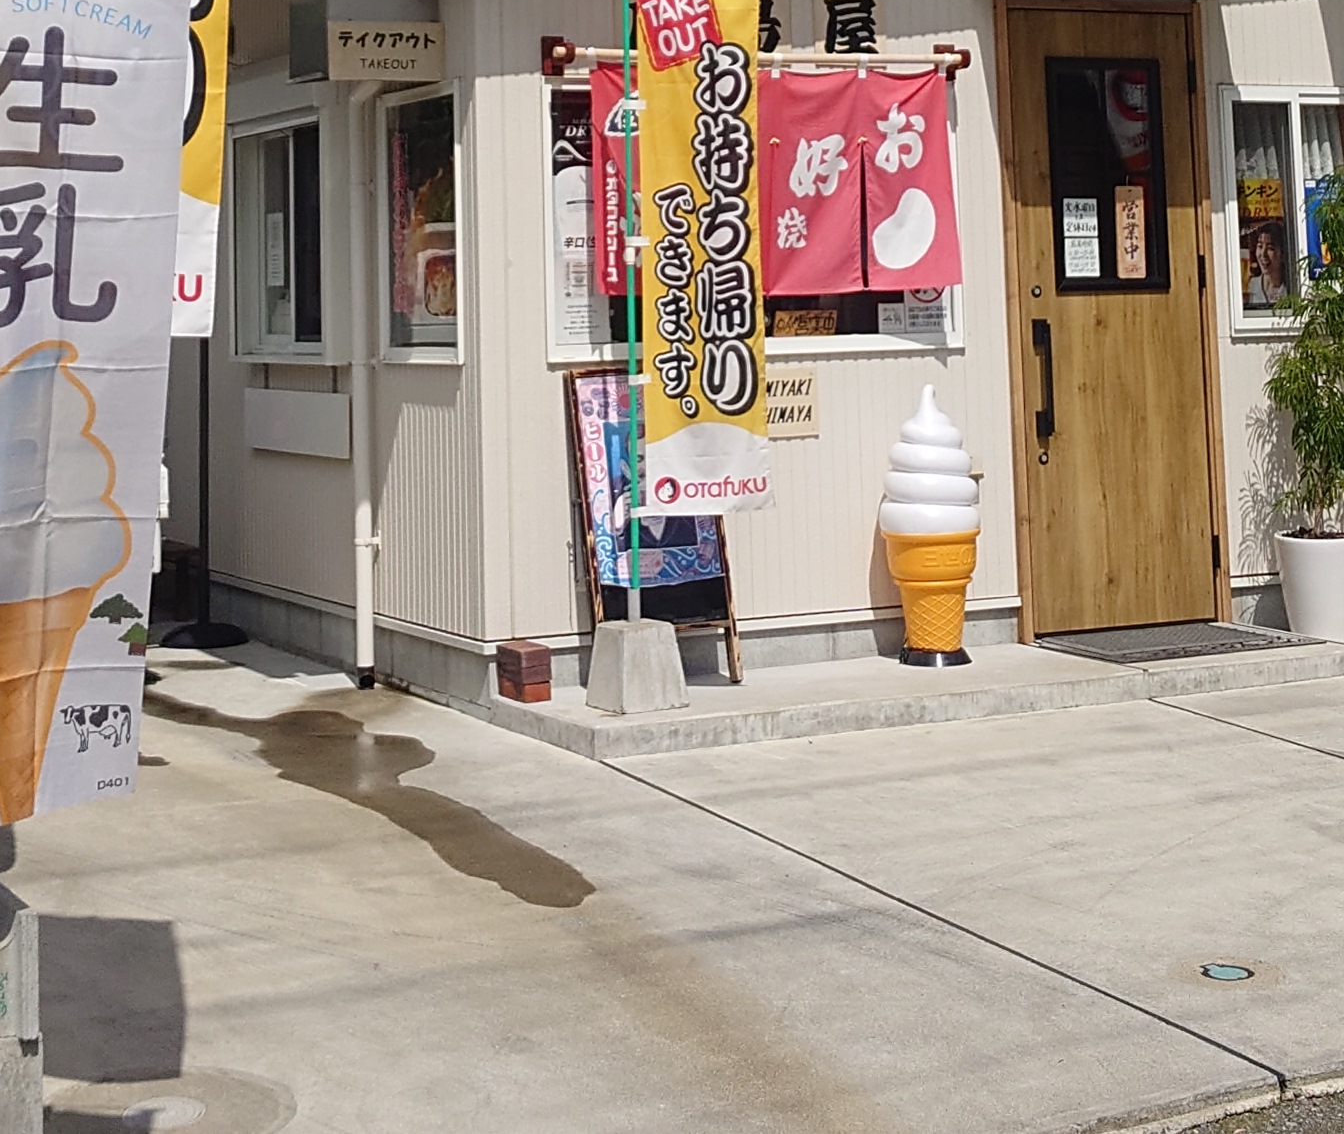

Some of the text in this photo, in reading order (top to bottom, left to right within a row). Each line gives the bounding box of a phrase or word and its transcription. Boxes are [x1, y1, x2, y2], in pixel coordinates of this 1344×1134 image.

[338, 31, 437, 49] テイクアウト
[658, 16, 708, 57] OUT
[359, 58, 417, 70] TAKEOUT
[695, 42, 756, 414] お持ち帰り
[1122, 200, 1140, 260] 営業中
[655, 184, 699, 418] できます。
[97, 776, 129, 790] D401
